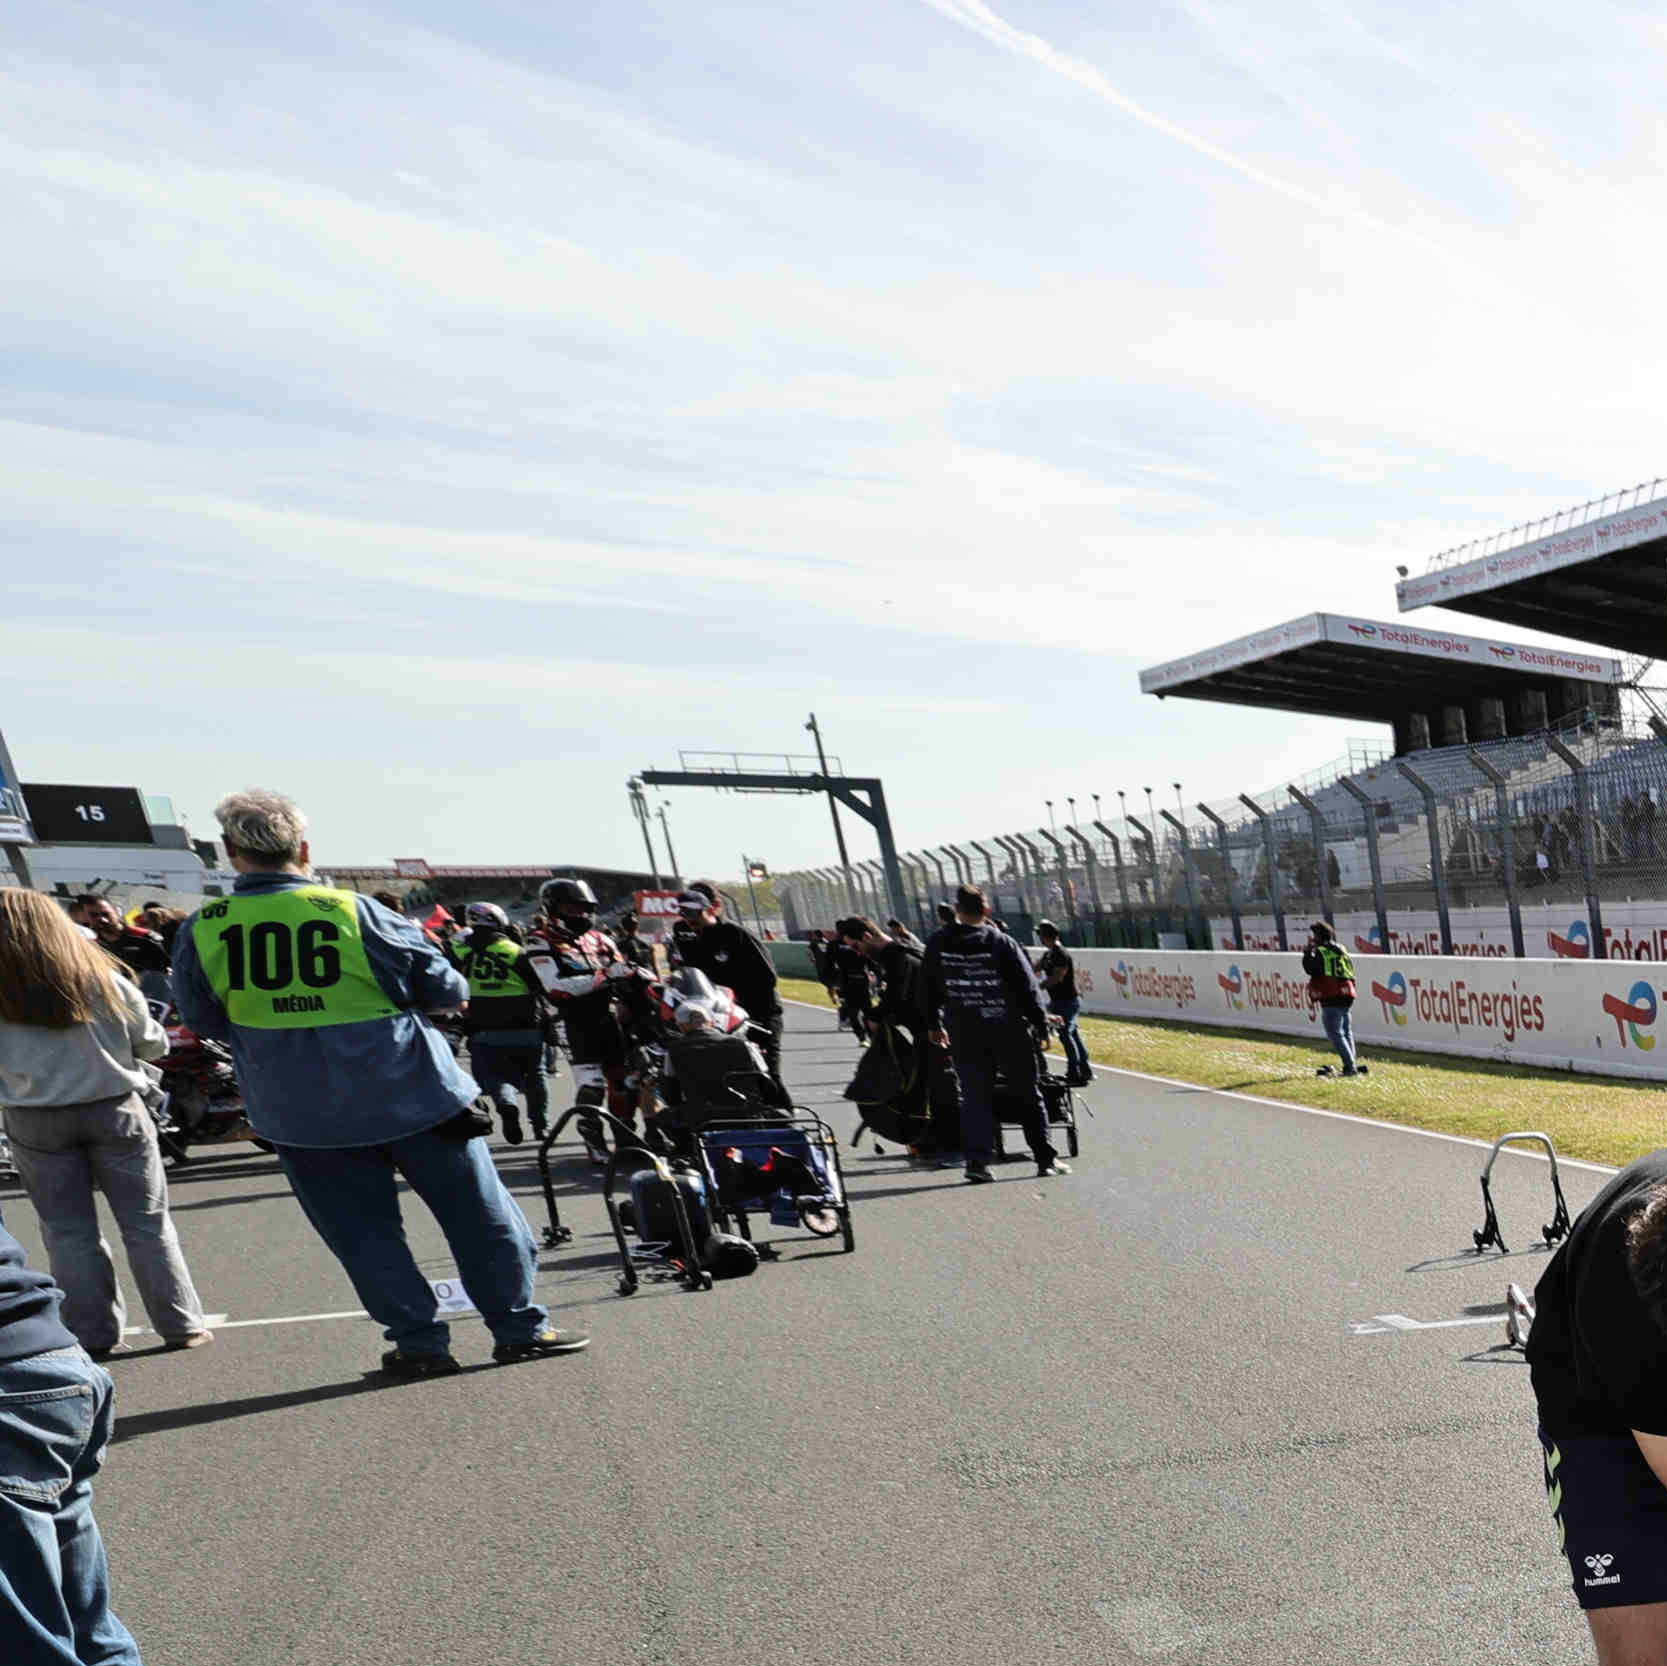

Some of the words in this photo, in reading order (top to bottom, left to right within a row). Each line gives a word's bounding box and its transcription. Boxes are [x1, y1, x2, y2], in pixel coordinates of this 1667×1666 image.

[1378, 626, 1471, 655] TotalEnergies
[1517, 648, 1602, 674] TotalEnergies
[75, 805, 106, 821] 15
[217, 919, 342, 992] 106
[1128, 963, 1197, 1009] TotalEnergies
[1243, 971, 1320, 1022] TotalEnerg
[272, 995, 326, 1015] MÉDIA
[1409, 978, 1546, 1042] TotalEnergies
[1583, 1573, 1621, 1587] hummel
